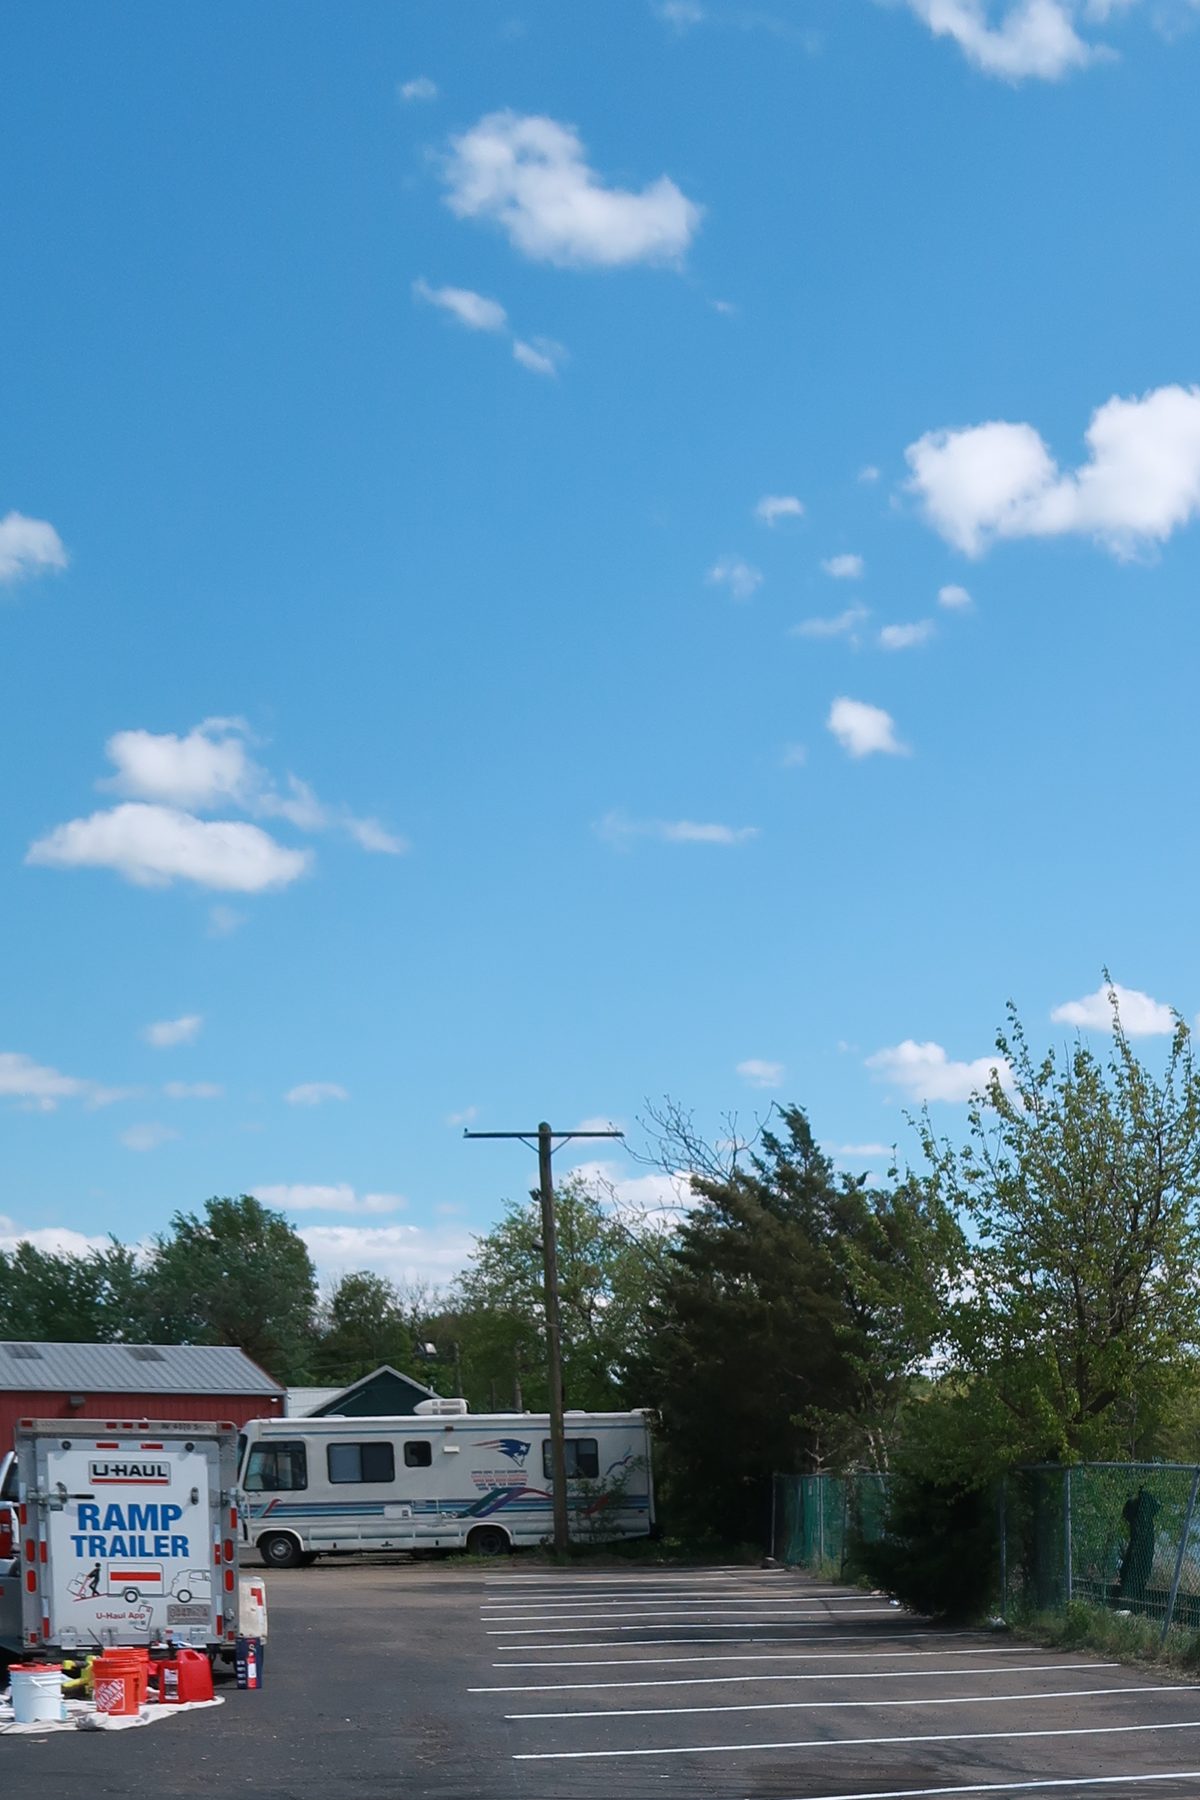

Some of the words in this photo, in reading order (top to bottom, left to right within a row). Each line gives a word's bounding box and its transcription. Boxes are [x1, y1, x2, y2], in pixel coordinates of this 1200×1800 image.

[92, 1463, 168, 1477] U-HAUL
[77, 1503, 183, 1531] RAMP
[70, 1535, 190, 1558] TRAILER
[96, 1612, 126, 1620] U-Haul
[128, 1612, 146, 1621] App
